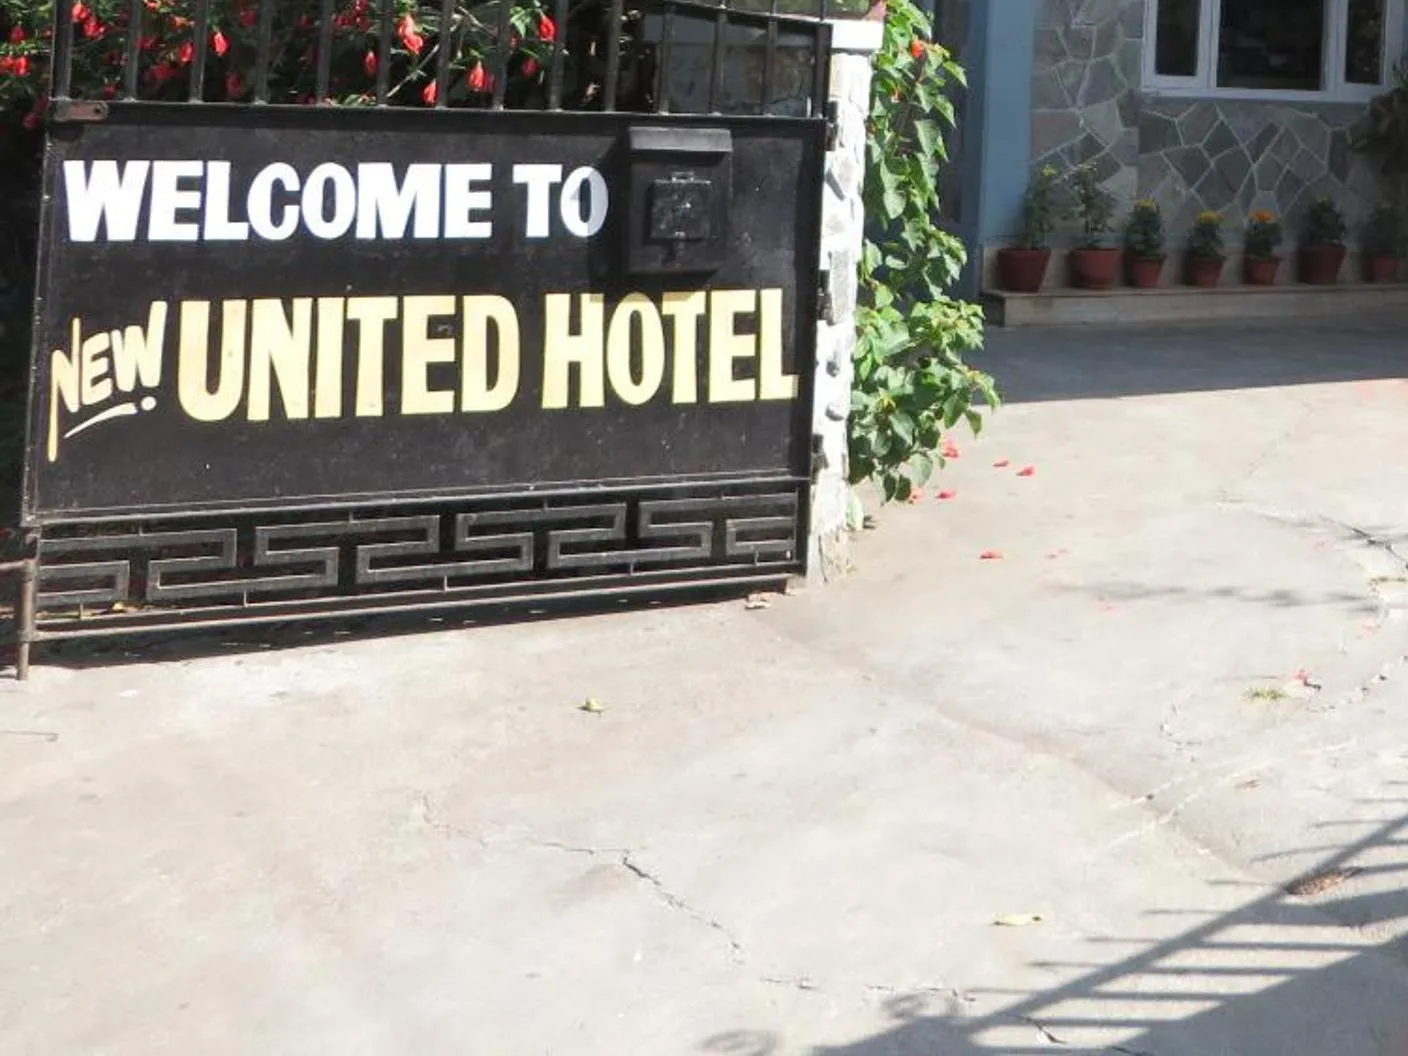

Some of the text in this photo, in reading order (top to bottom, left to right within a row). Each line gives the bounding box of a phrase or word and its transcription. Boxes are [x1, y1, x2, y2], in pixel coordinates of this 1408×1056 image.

[63, 160, 608, 243] WELCOME TO
[178, 295, 520, 422] UNITED
[541, 288, 799, 409] HOTEL
